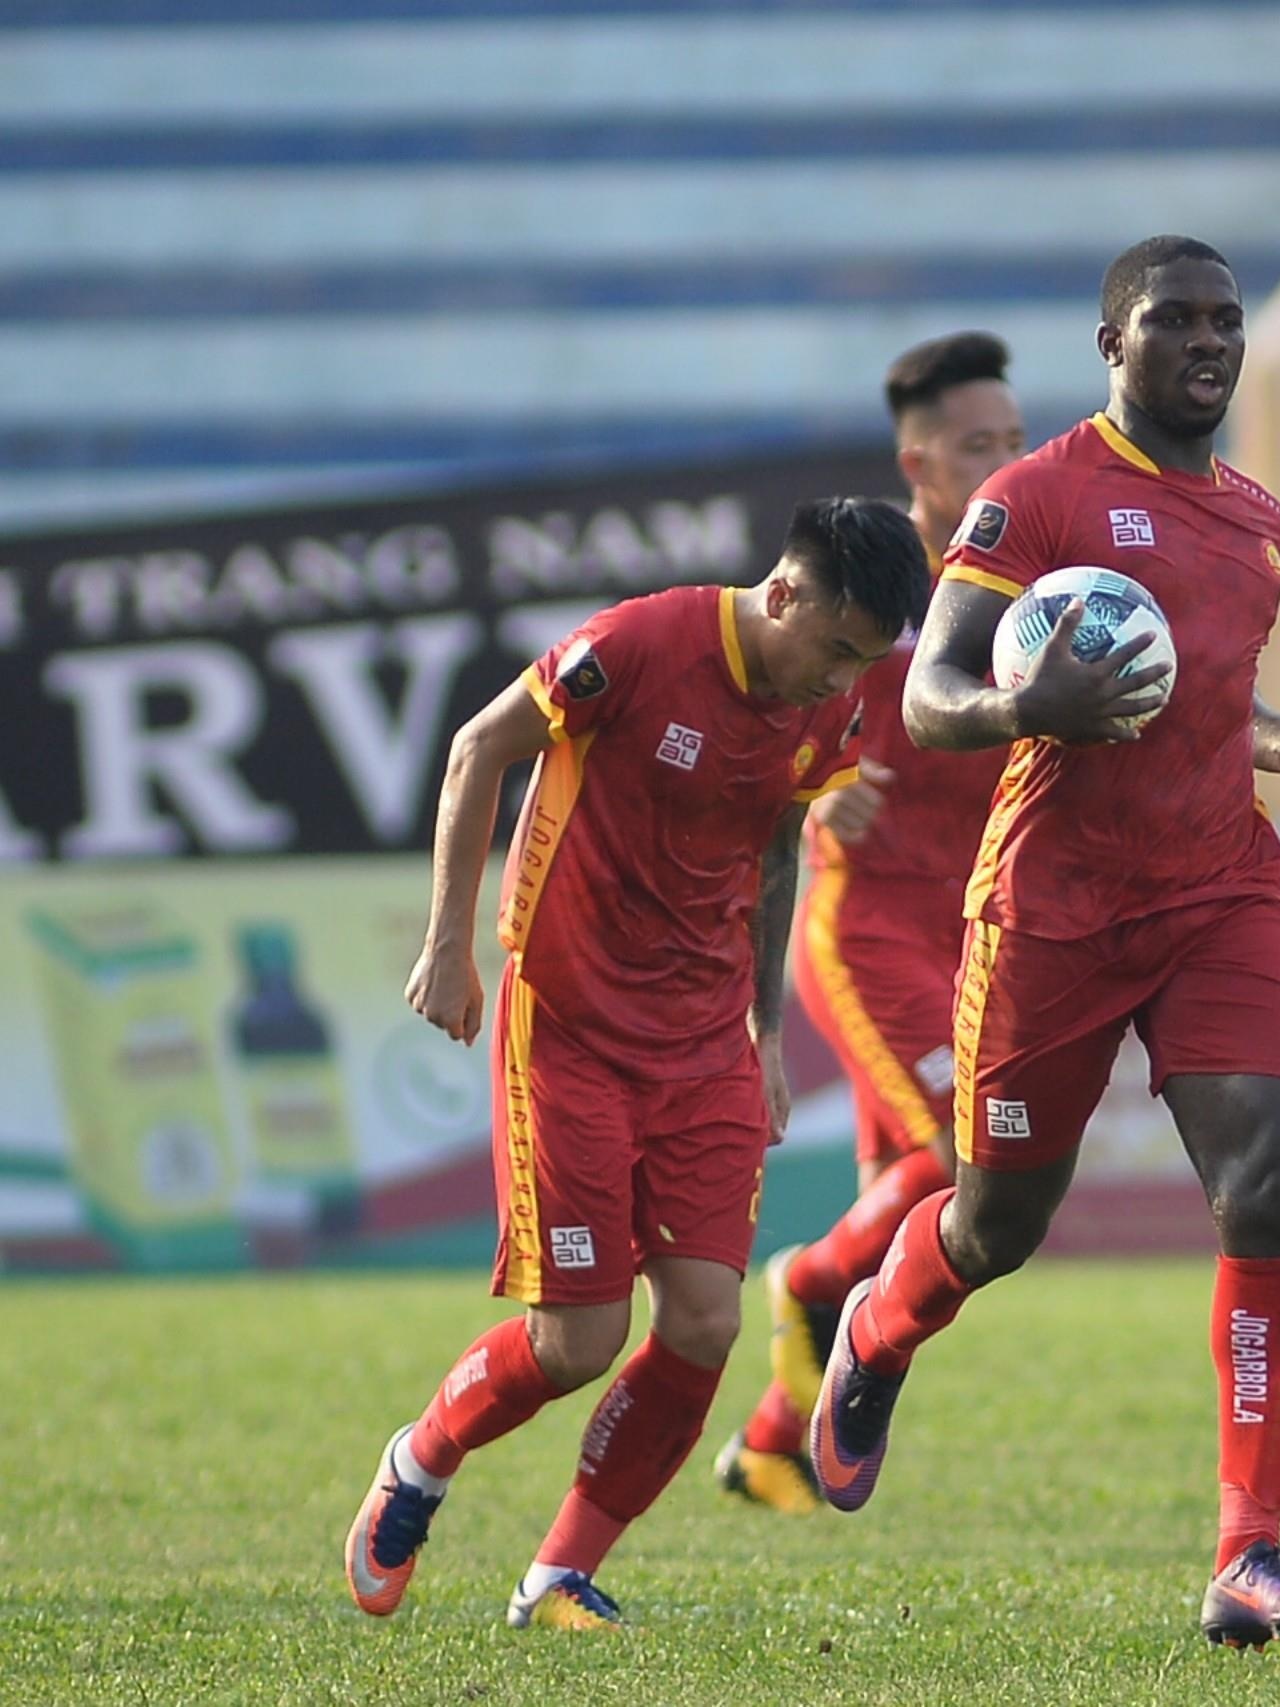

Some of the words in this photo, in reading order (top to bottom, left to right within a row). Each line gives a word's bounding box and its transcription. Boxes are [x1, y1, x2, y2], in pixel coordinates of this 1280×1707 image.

[48, 522, 463, 637] TRANG
[487, 494, 752, 593] NAM
[1230, 1308, 1271, 1424] JOGARBOLA
